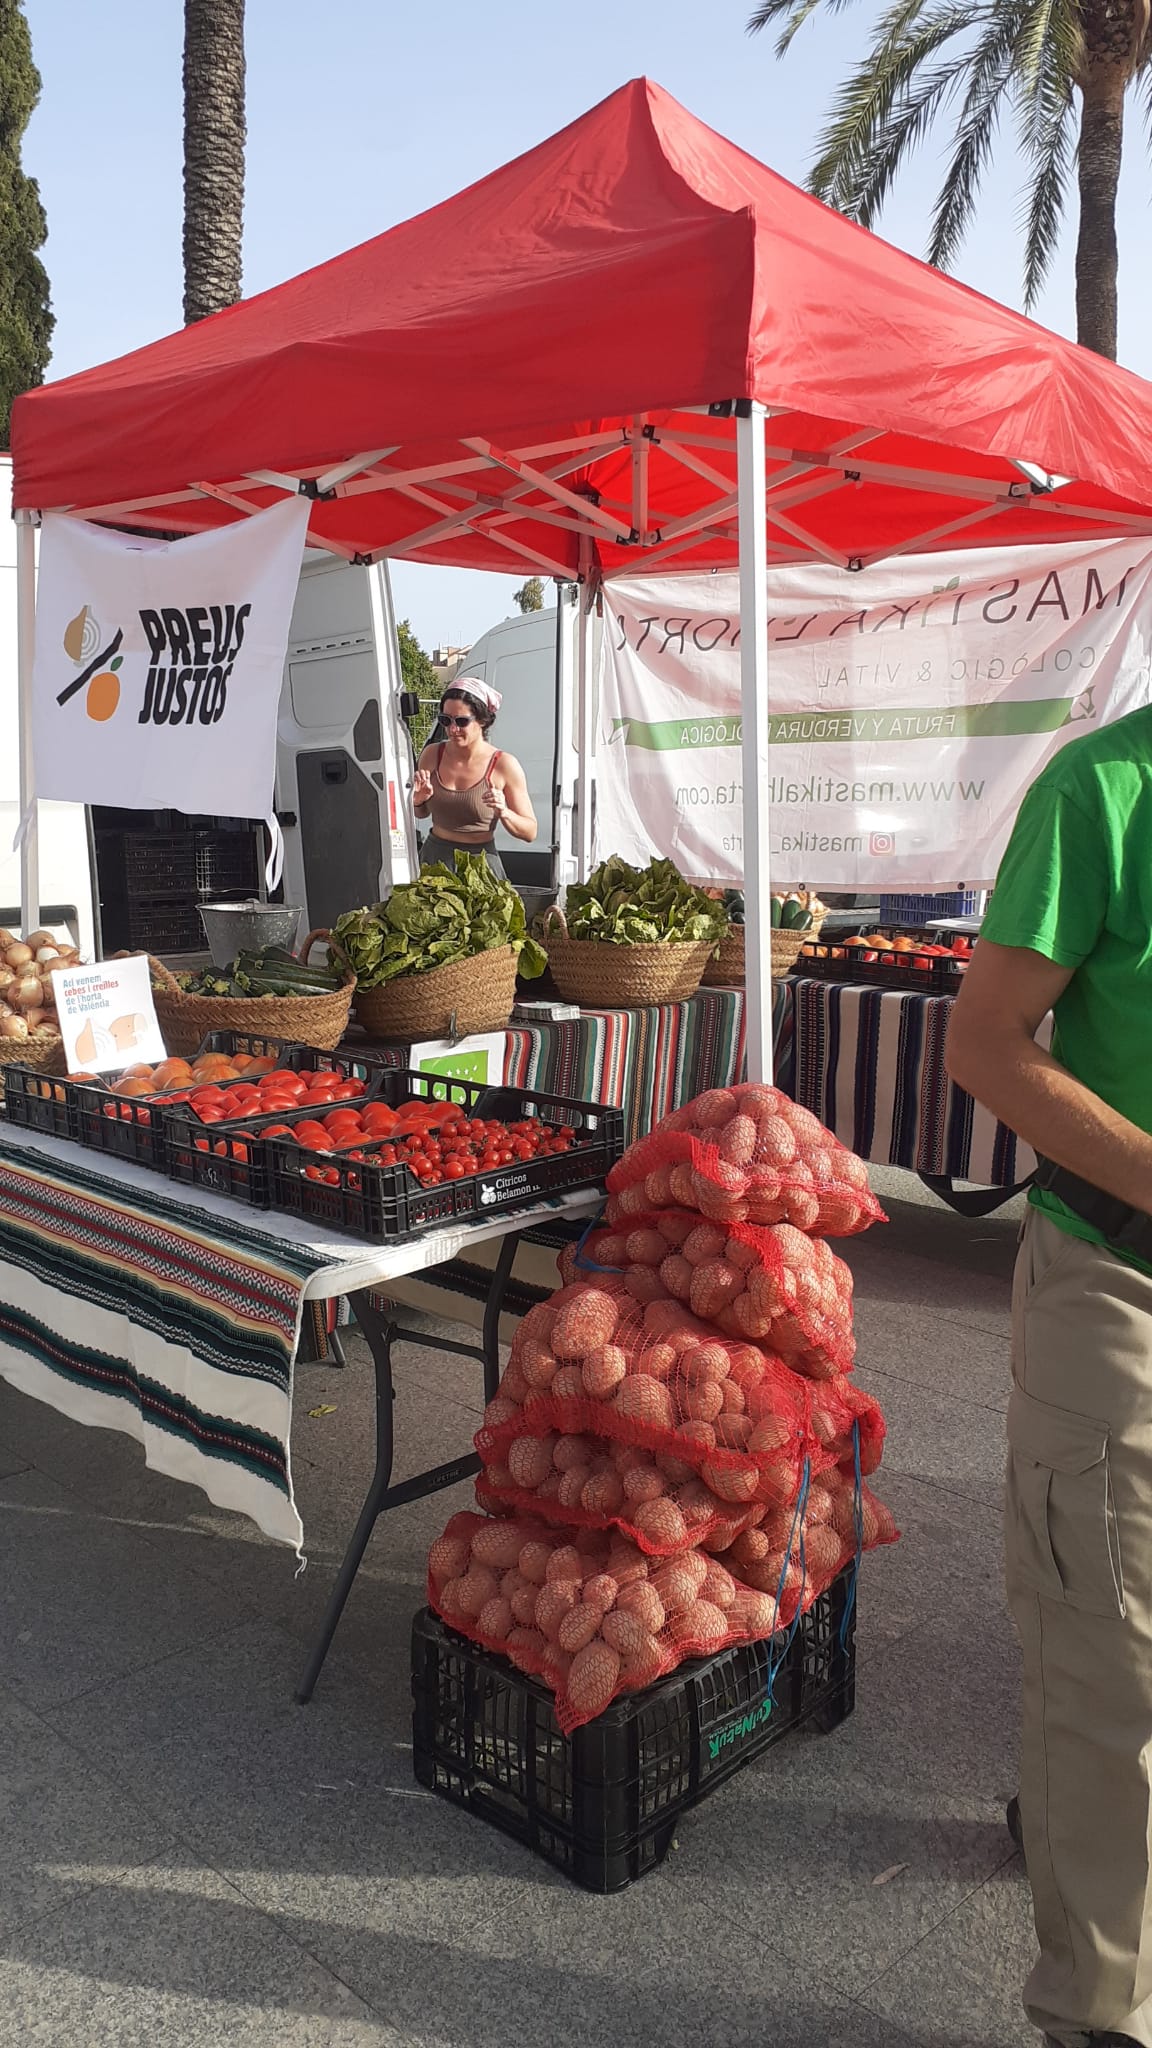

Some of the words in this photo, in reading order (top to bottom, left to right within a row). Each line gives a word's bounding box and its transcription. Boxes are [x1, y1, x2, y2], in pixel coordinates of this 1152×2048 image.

[138, 603, 252, 665] PREUS
[137, 662, 234, 725] JUSTOS
[76, 975, 101, 985] venem
[65, 987, 86, 997] cebes
[66, 998, 76, 1006] de
[68, 1006, 77, 1014] de
[497, 1185, 531, 1202] Belamon
